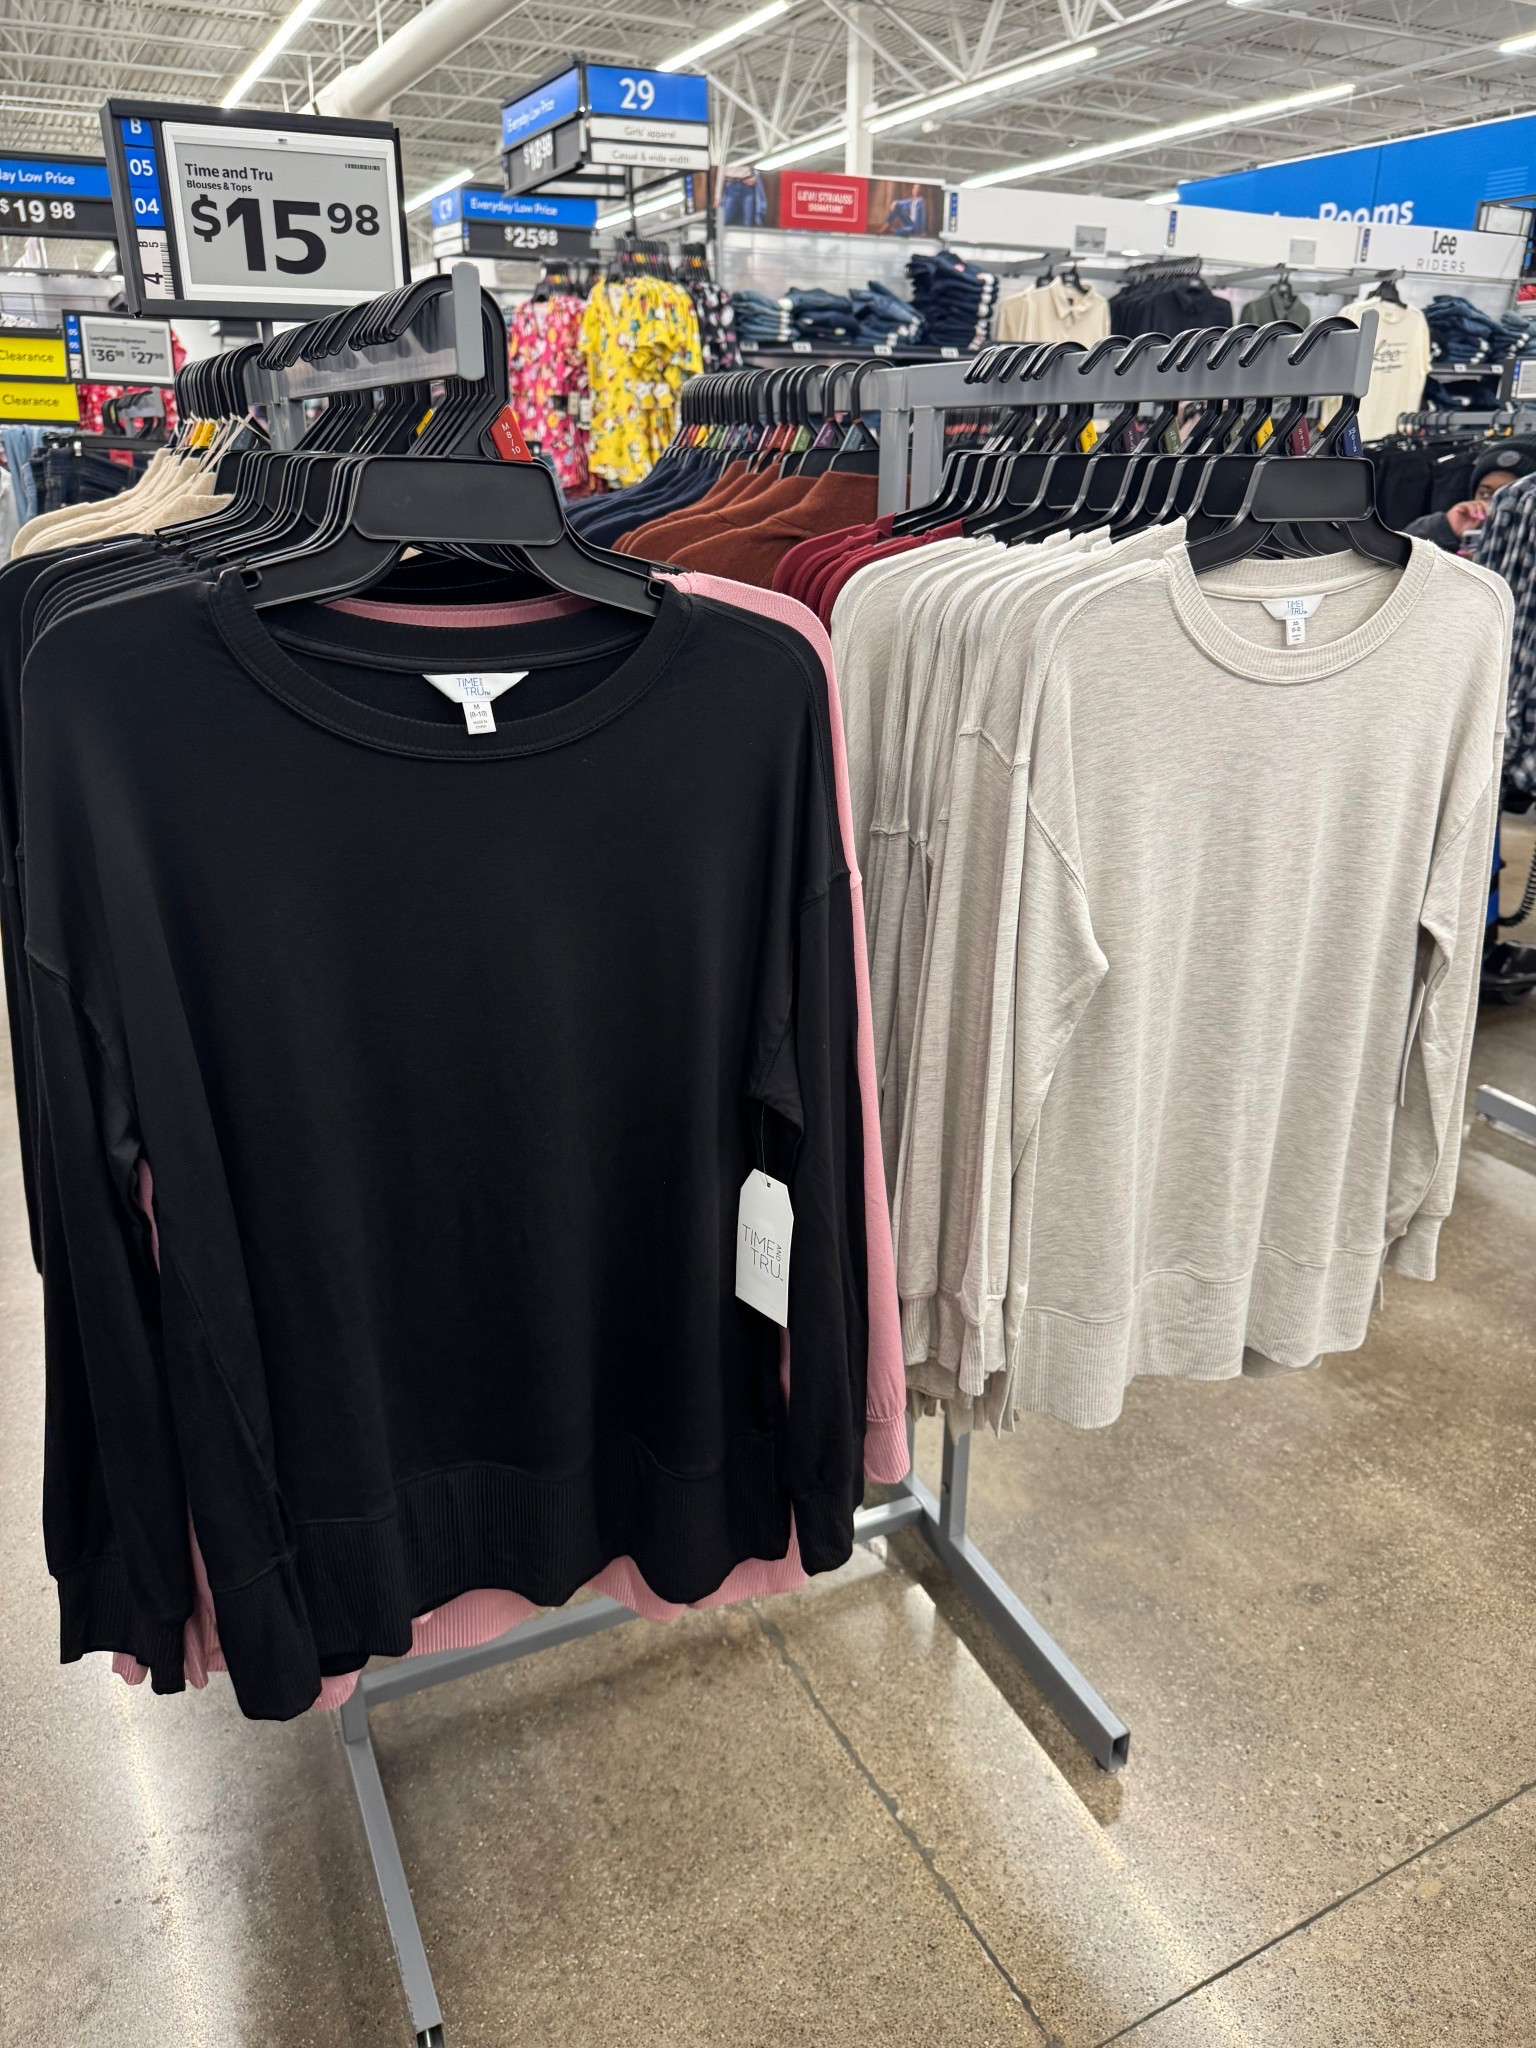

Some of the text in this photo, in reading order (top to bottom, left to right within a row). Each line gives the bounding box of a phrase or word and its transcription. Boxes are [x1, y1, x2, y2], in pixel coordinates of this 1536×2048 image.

[619, 77, 655, 112] 29
[130, 118, 142, 134] B
[129, 159, 154, 176] 05
[185, 163, 273, 182] Time and Tru
[18, 169, 43, 183] Low
[45, 171, 76, 186] Price
[186, 180, 252, 193] Blouses & Tops
[135, 198, 160, 215] 04
[470, 198, 558, 216] Everyday Low Price
[1431, 230, 1457, 255] Lee
[1416, 258, 1466, 273] RIDERS
[2, 394, 59, 407] Clearance
[456, 678, 480, 687] TIME
[742, 1223, 775, 1259] TIME
